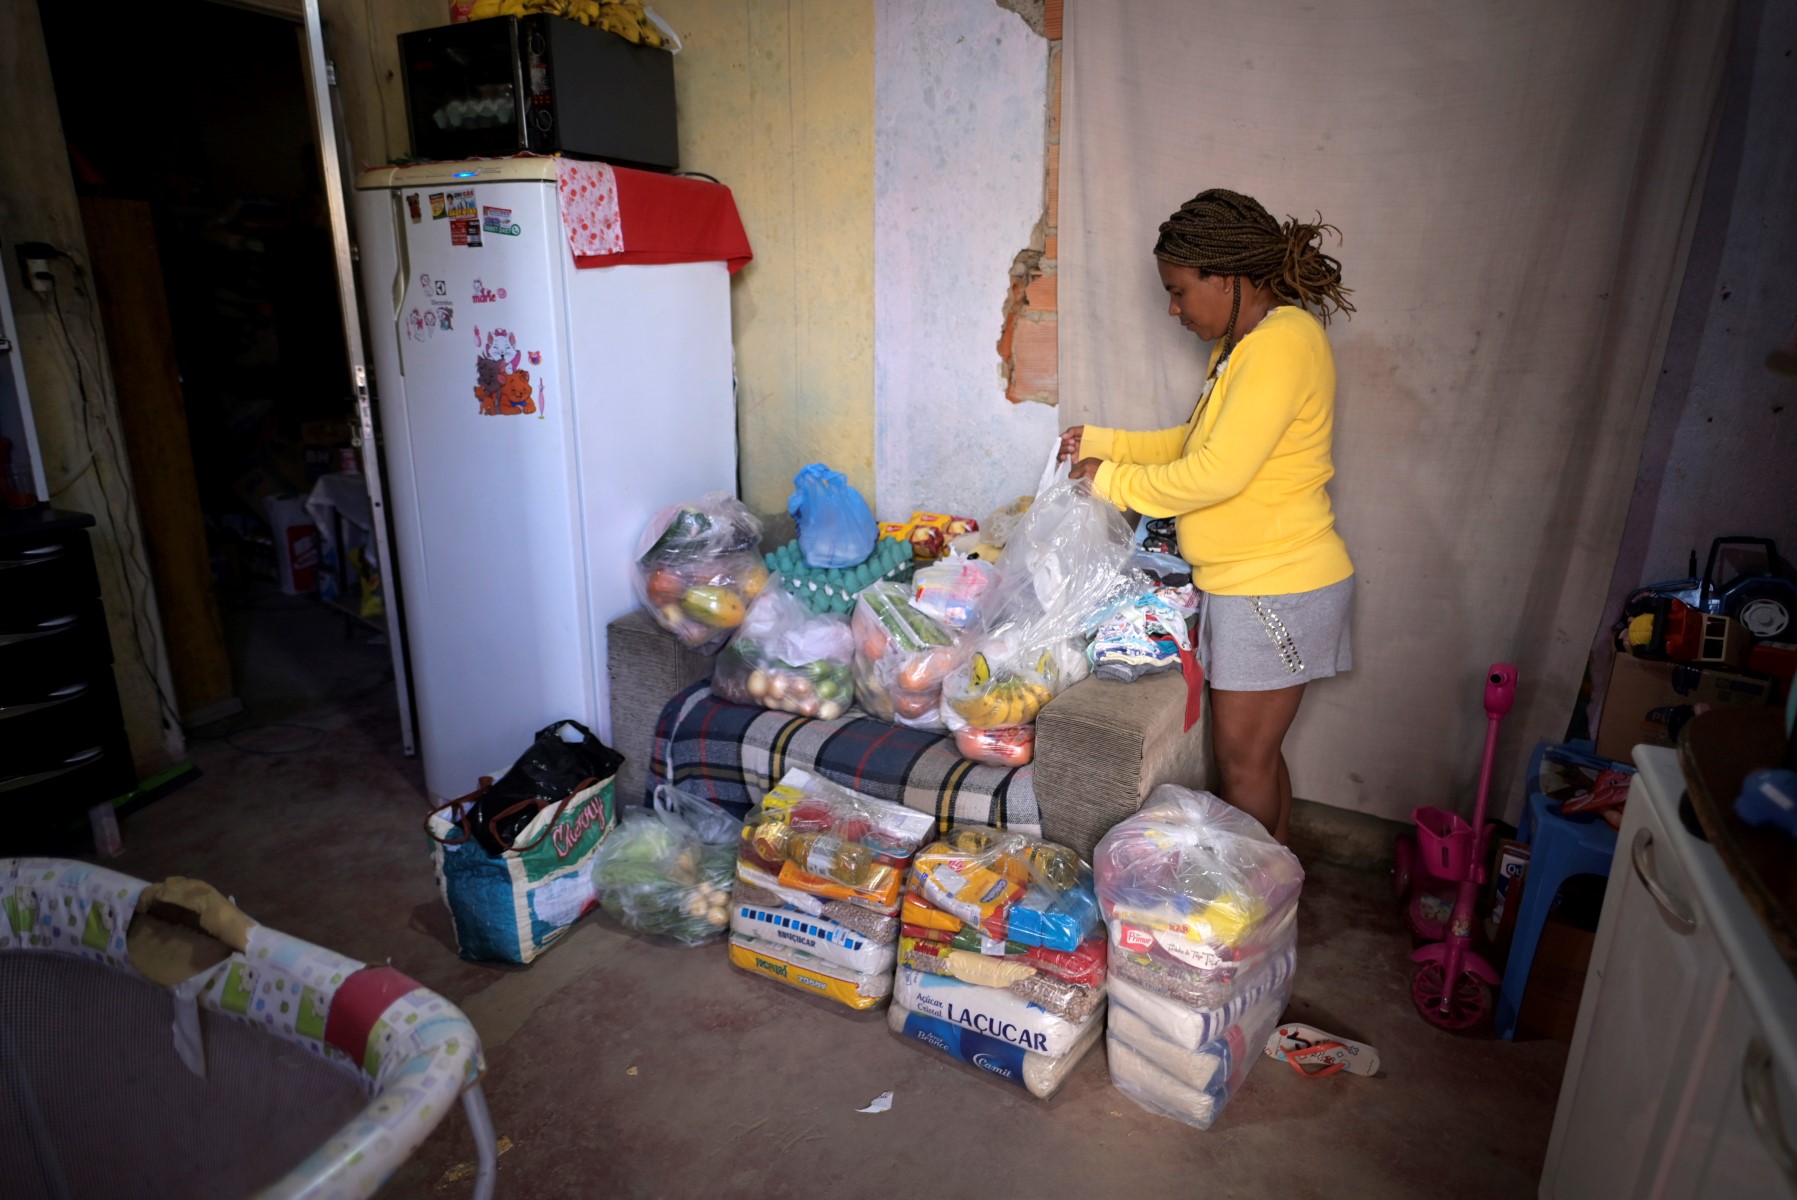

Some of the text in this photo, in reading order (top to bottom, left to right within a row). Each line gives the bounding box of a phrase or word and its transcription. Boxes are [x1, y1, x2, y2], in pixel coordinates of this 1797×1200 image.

[552, 796, 606, 857] Cherry
[1128, 930, 1152, 944] Primor
[916, 992, 944, 1009] Açúcar
[917, 1002, 943, 1018] Cristal
[917, 1030, 949, 1051] Branco
[977, 1057, 1012, 1078] Camil
